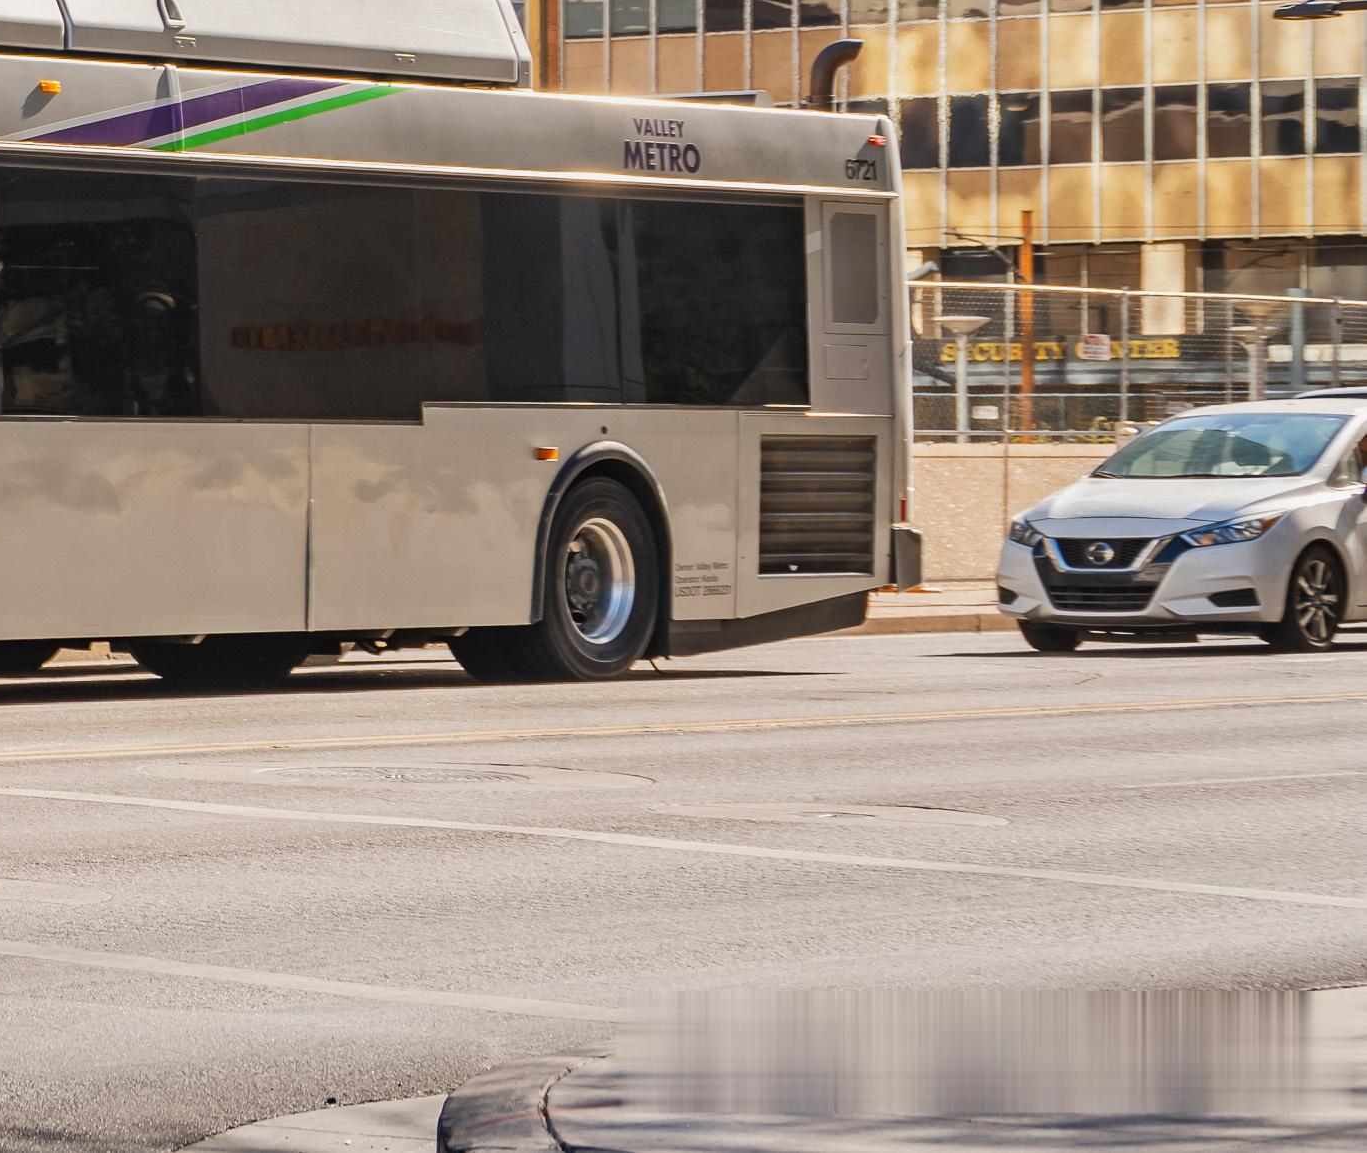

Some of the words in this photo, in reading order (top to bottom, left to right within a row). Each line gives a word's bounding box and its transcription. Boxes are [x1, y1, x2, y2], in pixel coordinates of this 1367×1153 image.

[633, 118, 685, 138] VALLEY
[623, 140, 701, 174] METRO
[845, 158, 877, 181] 6721
[940, 342, 1064, 362] SCURTY
[1075, 338, 1182, 359] NTER
